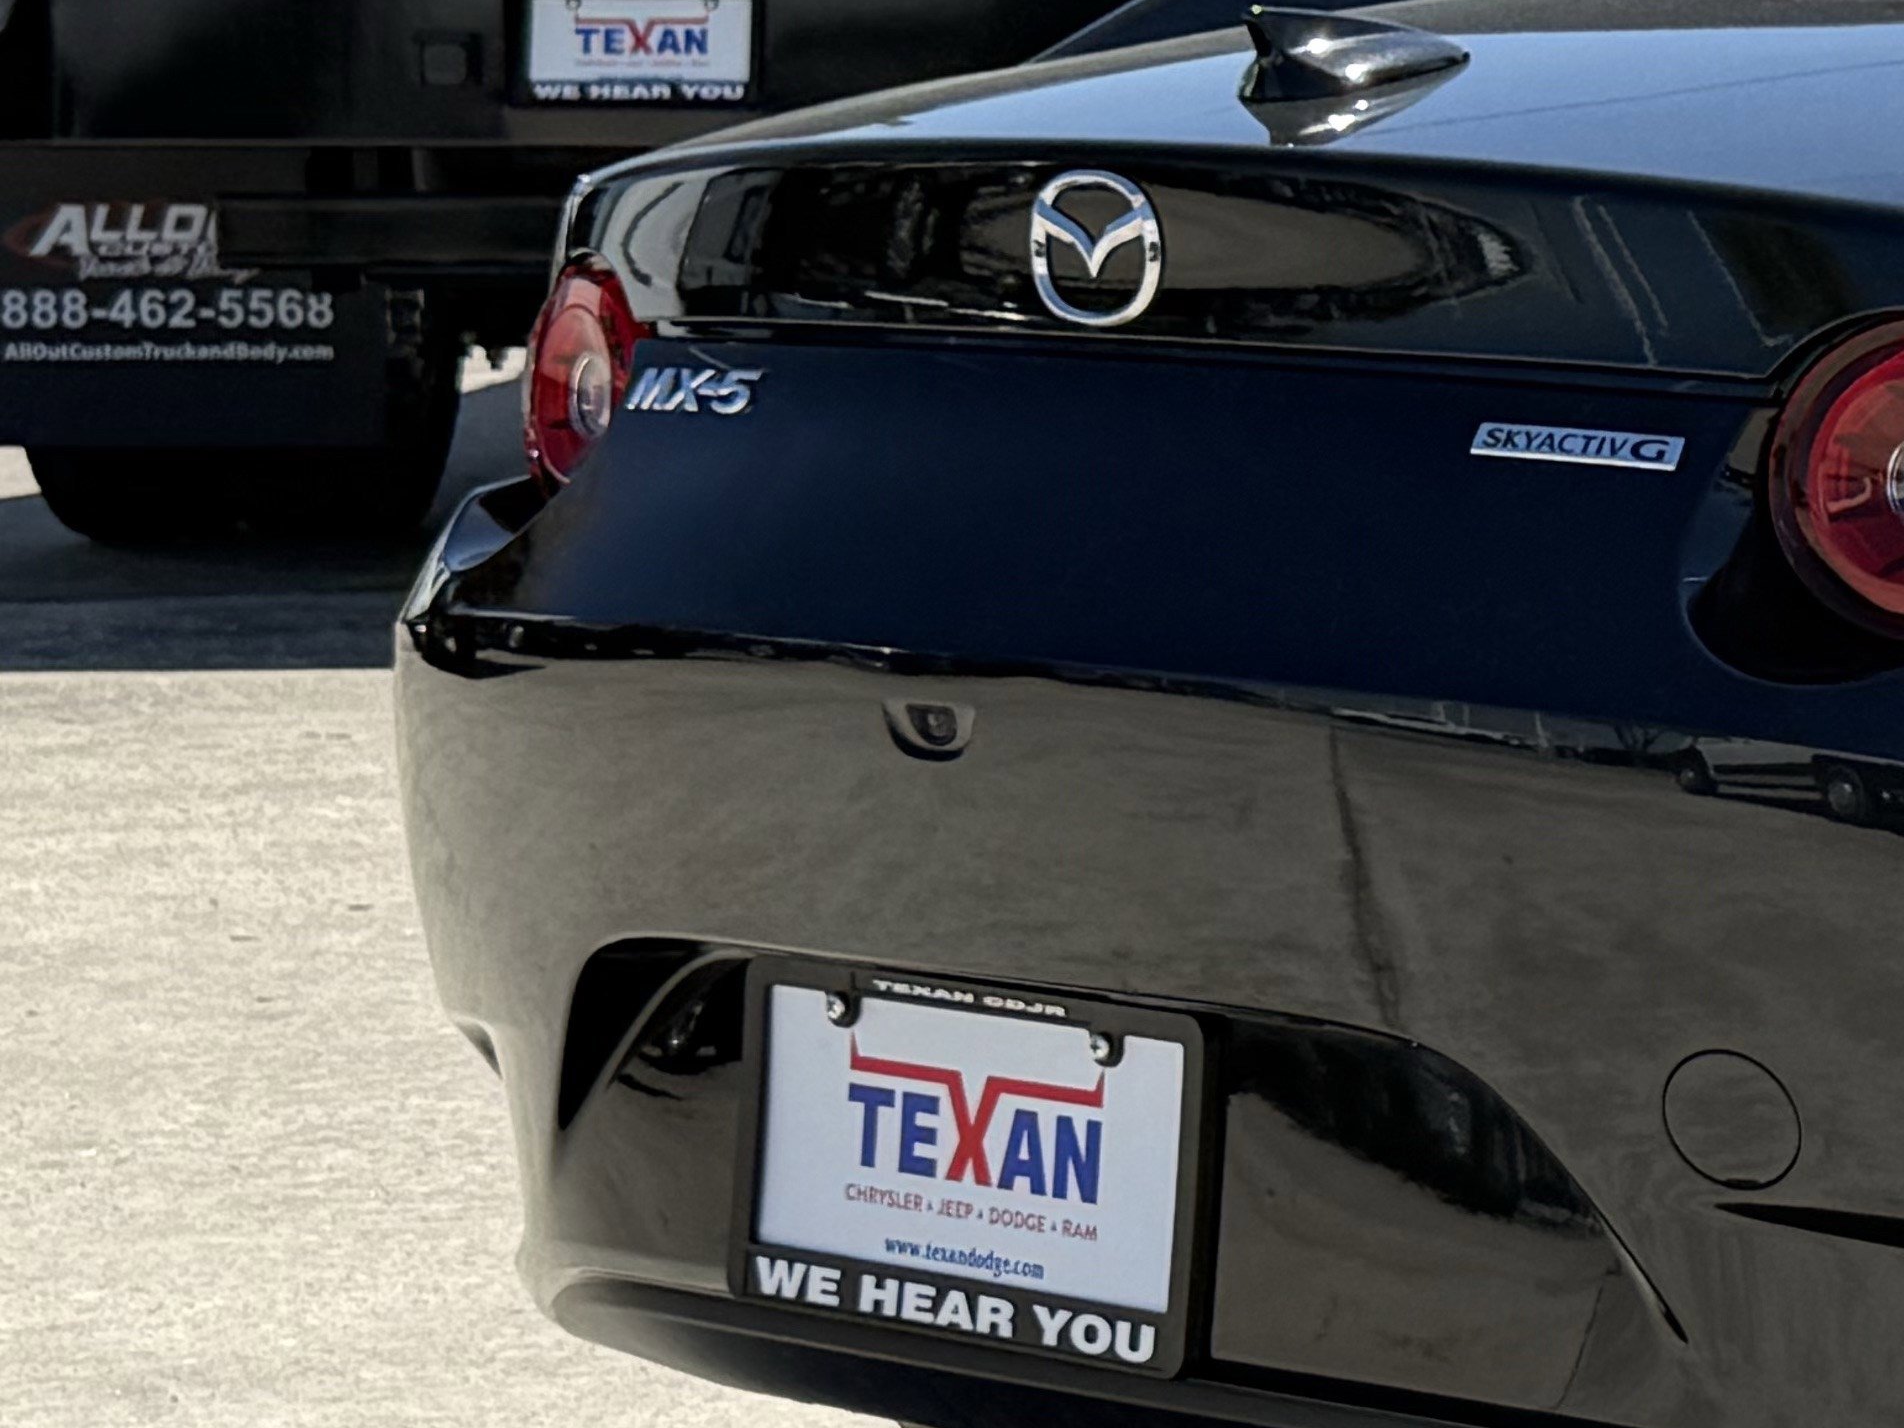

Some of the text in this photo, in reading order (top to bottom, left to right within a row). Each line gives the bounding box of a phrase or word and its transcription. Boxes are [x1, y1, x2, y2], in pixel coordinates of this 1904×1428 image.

[574, 19, 710, 56] TEXAN
[681, 83, 746, 102] YOU
[29, 204, 218, 257] ALLO
[1, 288, 335, 329] 888-462-5568
[626, 367, 765, 414] MX-5
[873, 979, 975, 1003] TEXAN
[847, 1069, 1103, 1205] TEXAN
[844, 1182, 1099, 1242] CHRYSLER JEEP DODGE RAM
[884, 1235, 1045, 1281] www.texandodge.com
[755, 1255, 1156, 1365] WE HEAR YOU
